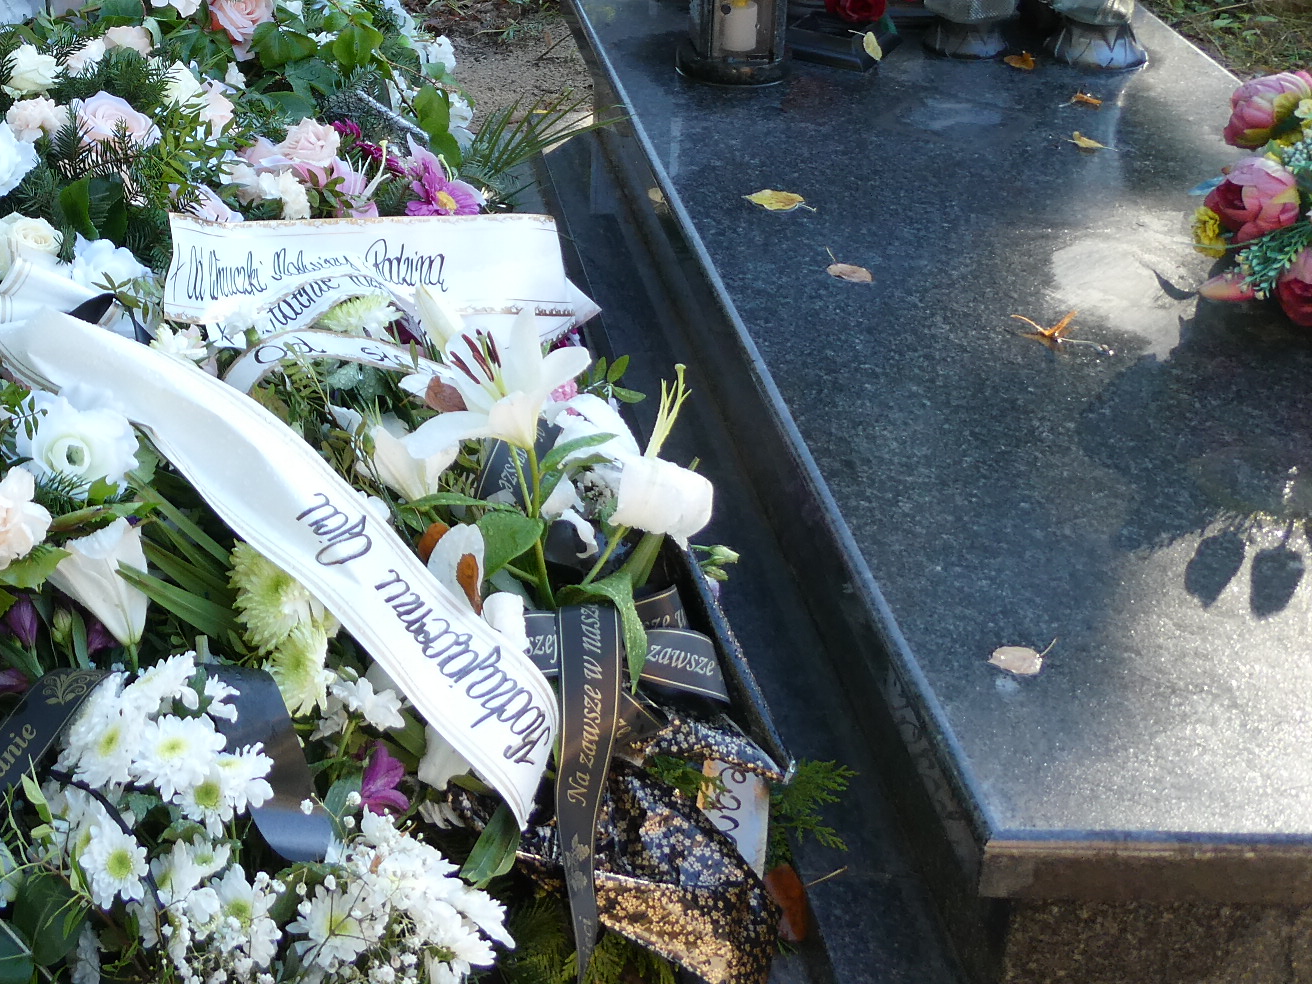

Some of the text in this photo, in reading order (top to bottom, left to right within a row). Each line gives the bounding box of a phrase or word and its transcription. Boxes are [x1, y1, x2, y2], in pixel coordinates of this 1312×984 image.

[295, 491, 373, 566] Ojcu
[584, 652, 604, 681] w
[646, 642, 716, 677] zawsze
[577, 684, 608, 768] zawsze
[567, 769, 591, 808] Na
